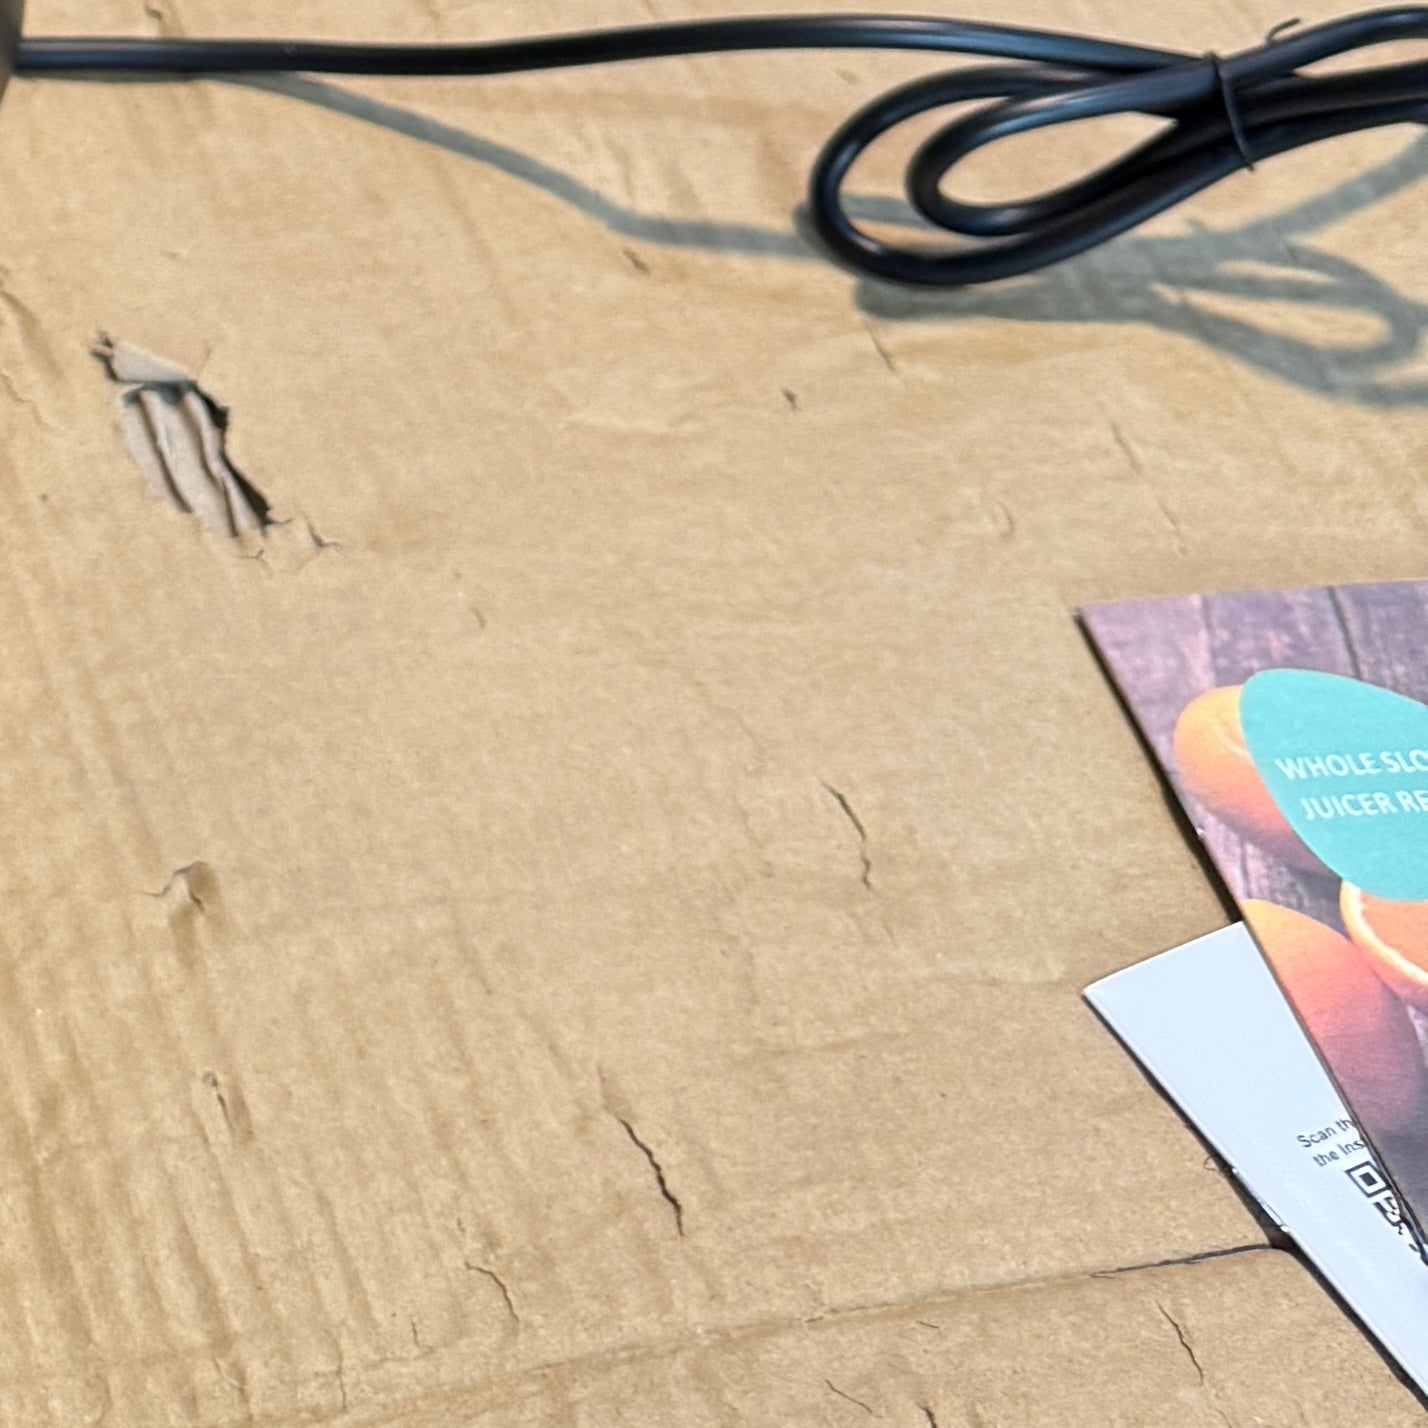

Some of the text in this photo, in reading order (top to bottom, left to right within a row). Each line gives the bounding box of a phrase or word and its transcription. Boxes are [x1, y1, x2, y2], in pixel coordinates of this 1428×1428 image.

[1274, 752, 1381, 781] WHOLE
[1300, 790, 1398, 822] JUICER
[1296, 1126, 1337, 1149] Scan
[1312, 1151, 1340, 1168] the
